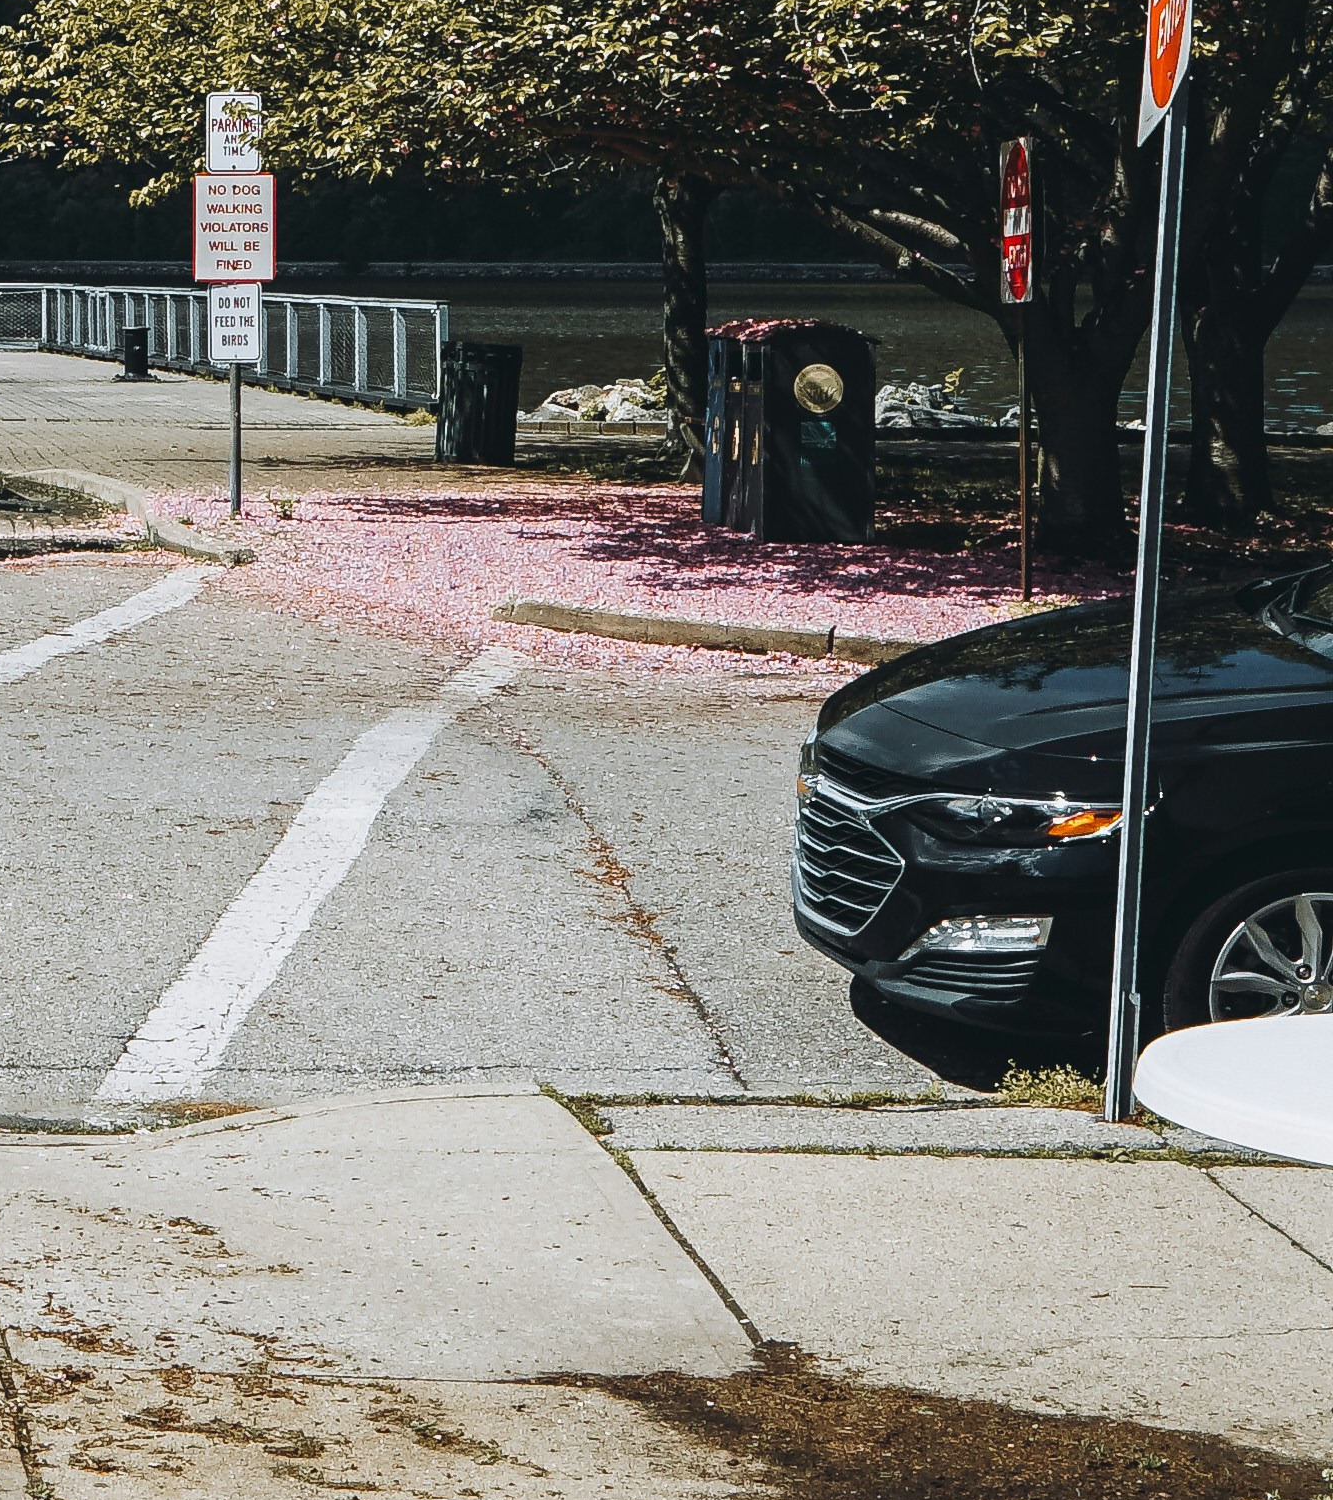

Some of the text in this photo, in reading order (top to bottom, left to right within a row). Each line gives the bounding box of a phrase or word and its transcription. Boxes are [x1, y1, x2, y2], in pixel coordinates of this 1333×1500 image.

[211, 118, 257, 133] PARKING
[223, 146, 246, 157] TIME
[208, 184, 261, 196] NO DOG
[206, 203, 263, 215] WALKING
[200, 222, 269, 233] VIOLATORS
[208, 240, 261, 252] WILL BE
[216, 259, 253, 271] FINED
[218, 296, 251, 309] DO NOT
[214, 315, 255, 328] FEED THE
[221, 334, 249, 347] BIRDS
